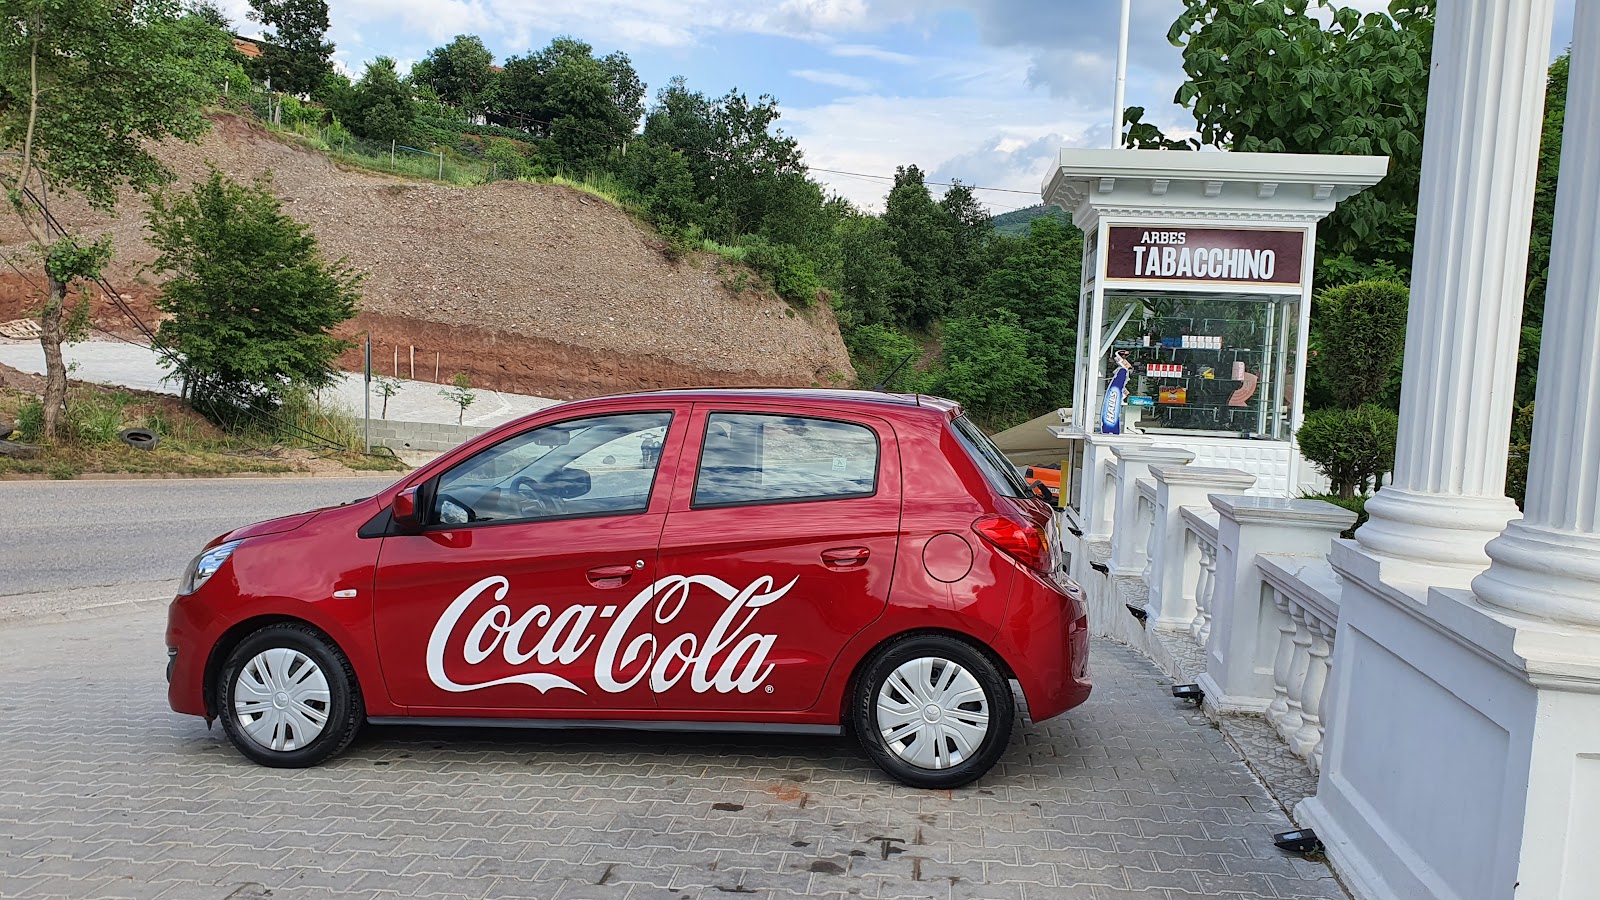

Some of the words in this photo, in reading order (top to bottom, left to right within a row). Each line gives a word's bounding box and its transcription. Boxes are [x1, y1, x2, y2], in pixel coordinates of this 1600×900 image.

[1141, 231, 1186, 245] ARBES
[1133, 246, 1276, 280] TABACCHINO
[1105, 390, 1118, 424] HALLS
[426, 573, 800, 695] Coca-Cola
